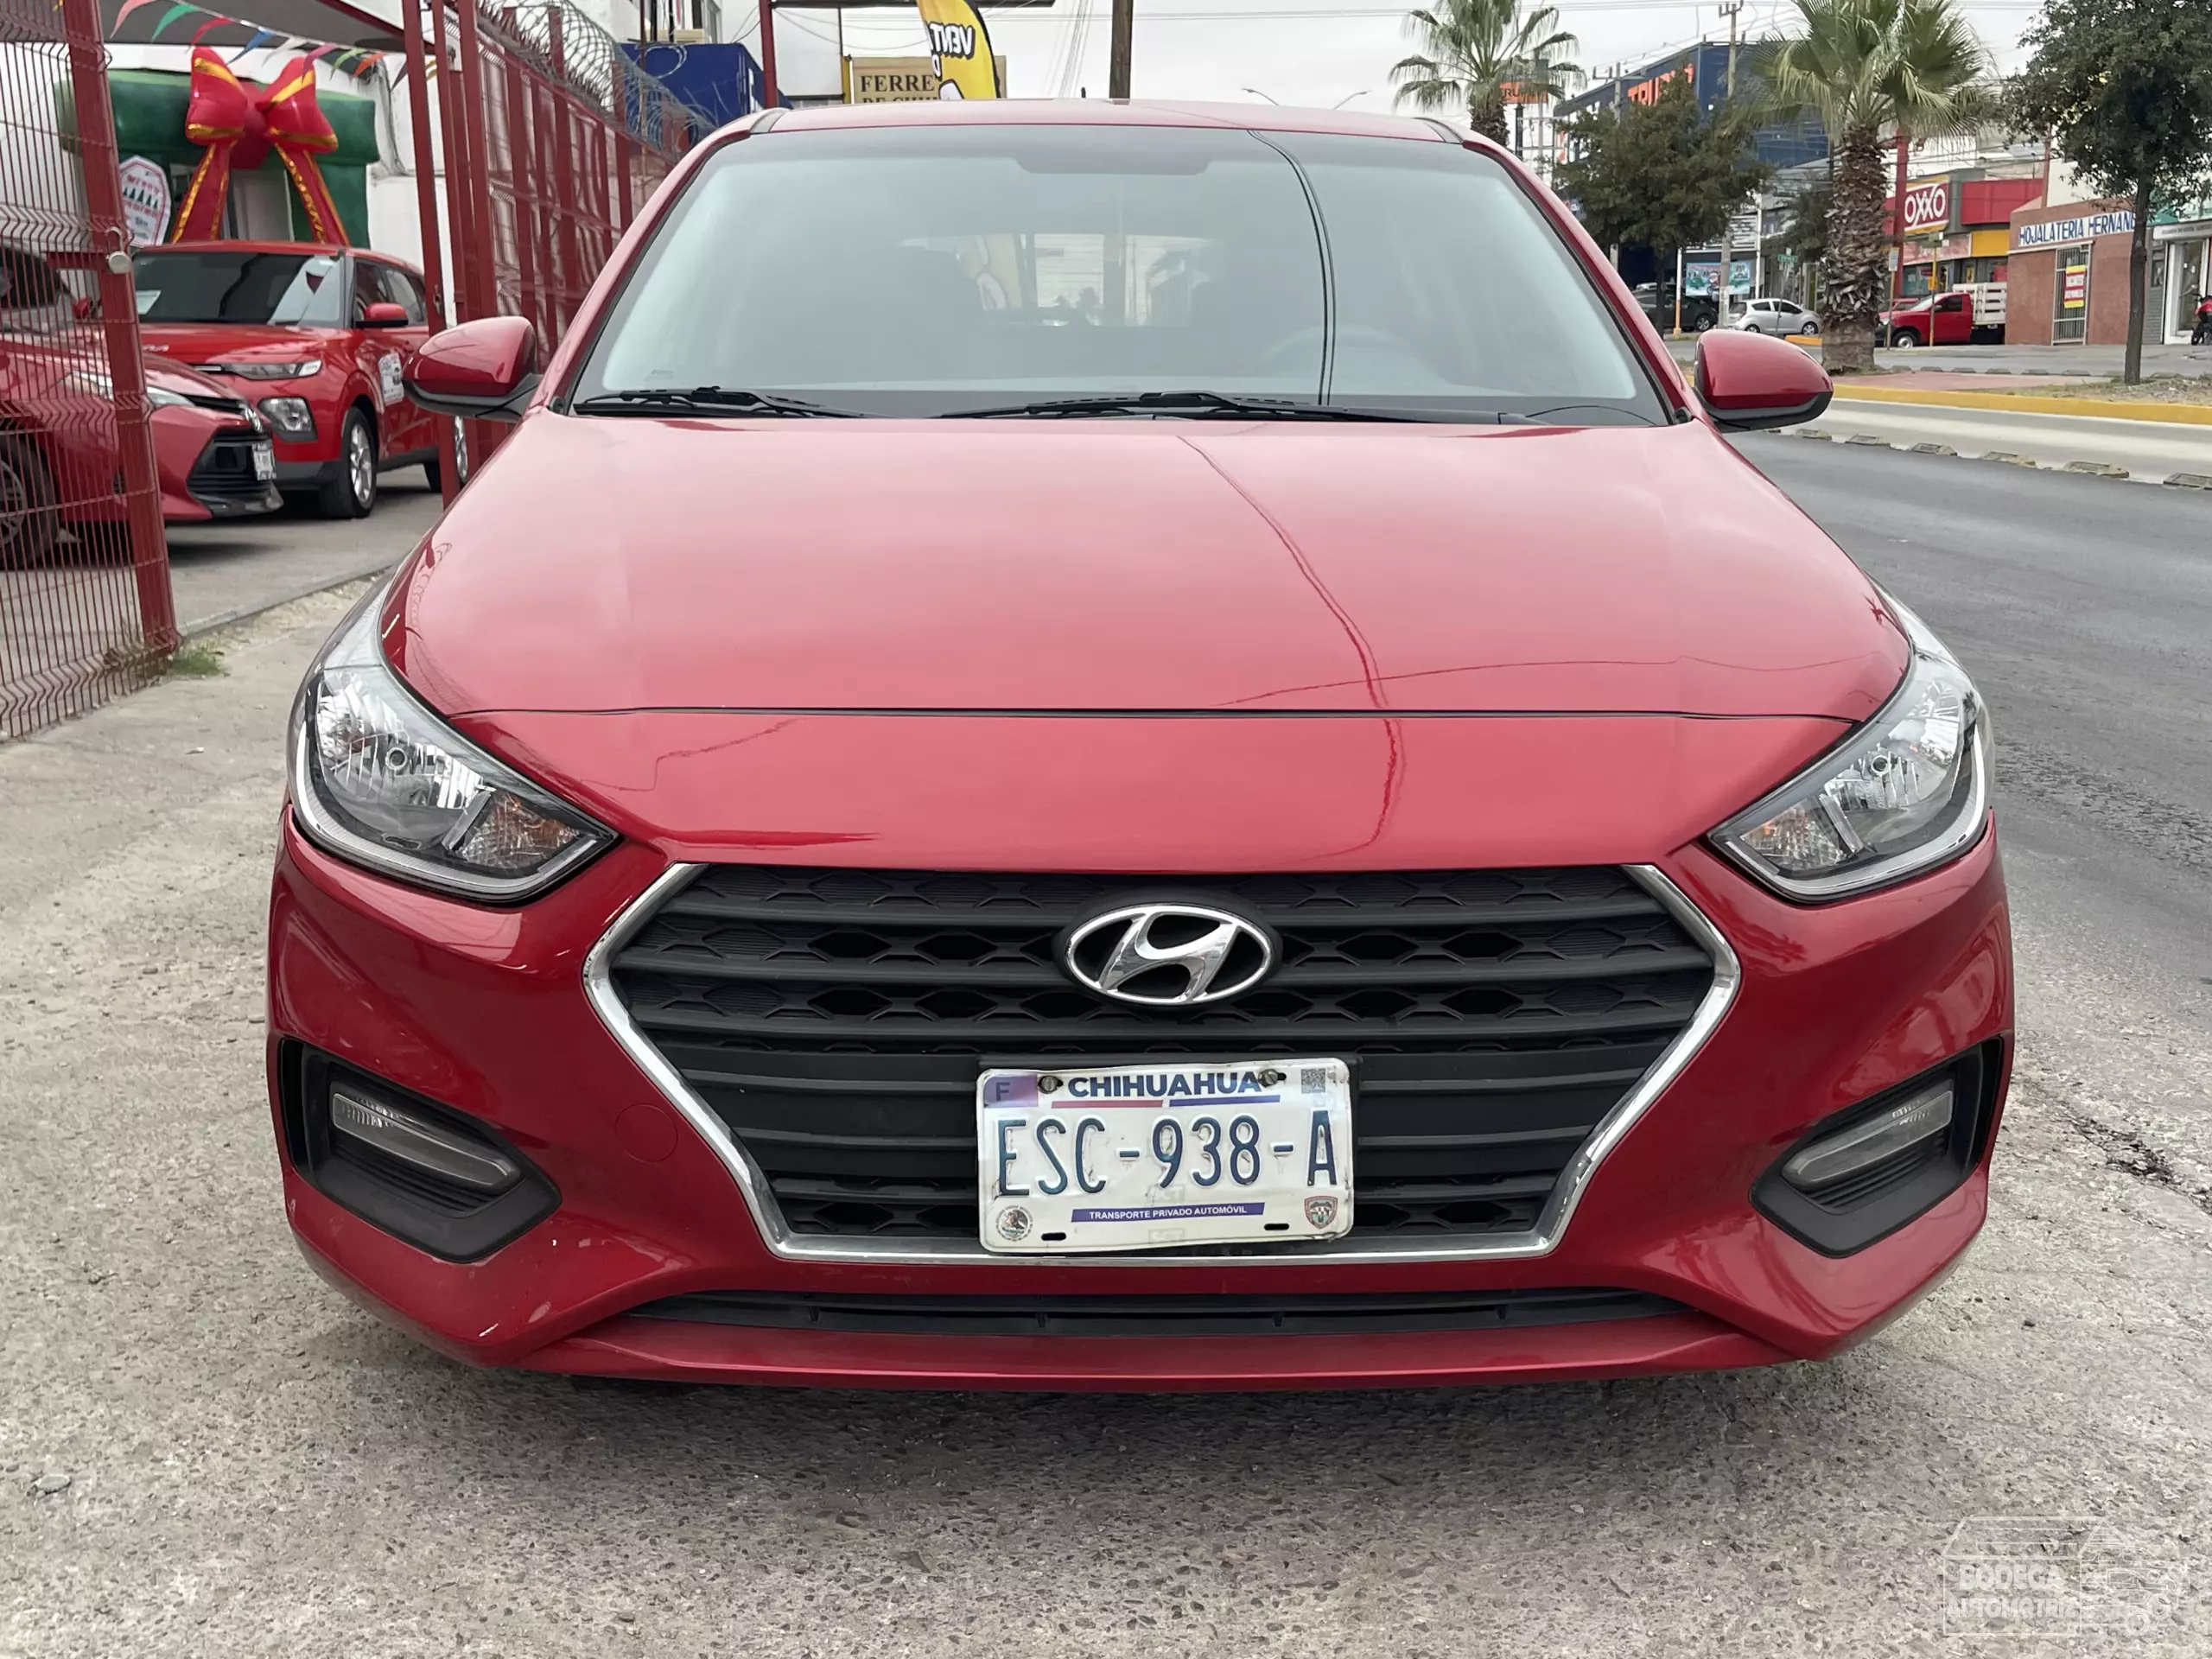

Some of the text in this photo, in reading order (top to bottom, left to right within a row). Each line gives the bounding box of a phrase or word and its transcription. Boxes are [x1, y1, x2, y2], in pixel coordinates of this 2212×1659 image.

[861, 74, 936, 92] FERRE
[1904, 183, 1946, 226] OXXO
[2019, 219, 2083, 245] HOJALATERIA
[995, 1083, 1010, 1101] F
[1068, 1071, 1262, 1097] CHIHUAHUA
[997, 1110, 1338, 1197] ESC-938-A
[1089, 1205, 1247, 1220] TRANSPORTE PRIVADO AUTOMÓVIL
